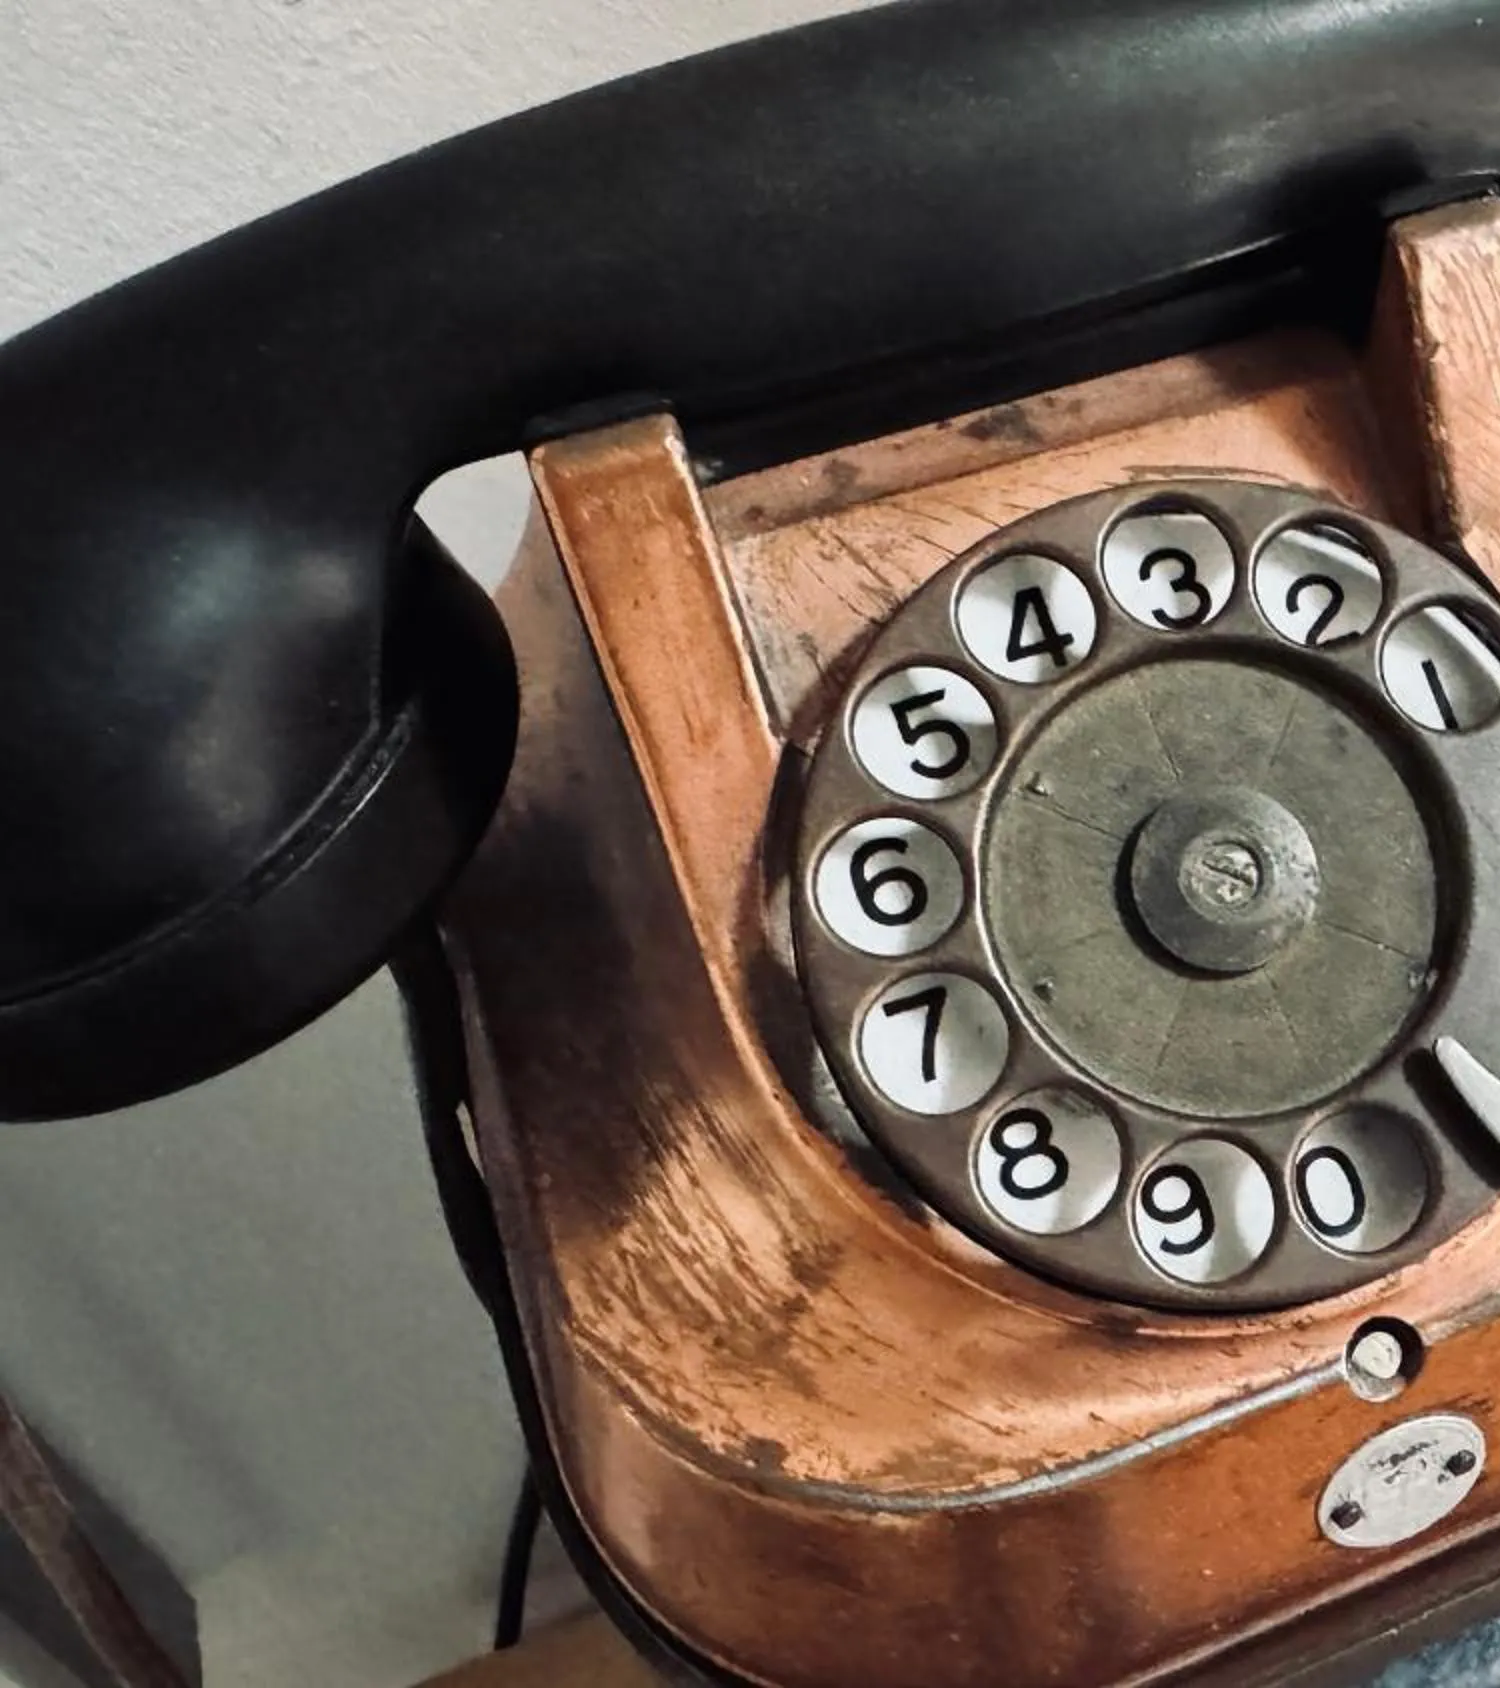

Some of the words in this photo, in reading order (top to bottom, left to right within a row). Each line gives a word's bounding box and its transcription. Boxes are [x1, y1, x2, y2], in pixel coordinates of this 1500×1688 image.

[1005, 586, 1074, 669] 4
[1138, 548, 1213, 631] 3
[1285, 574, 1361, 647] 2
[890, 688, 971, 780] 5
[1420, 658, 1460, 731] 1
[849, 837, 928, 927] 6
[881, 987, 948, 1083] 7
[988, 1107, 1071, 1201] 8
[1295, 1146, 1367, 1239] 0
[1139, 1164, 1217, 1257] 9
